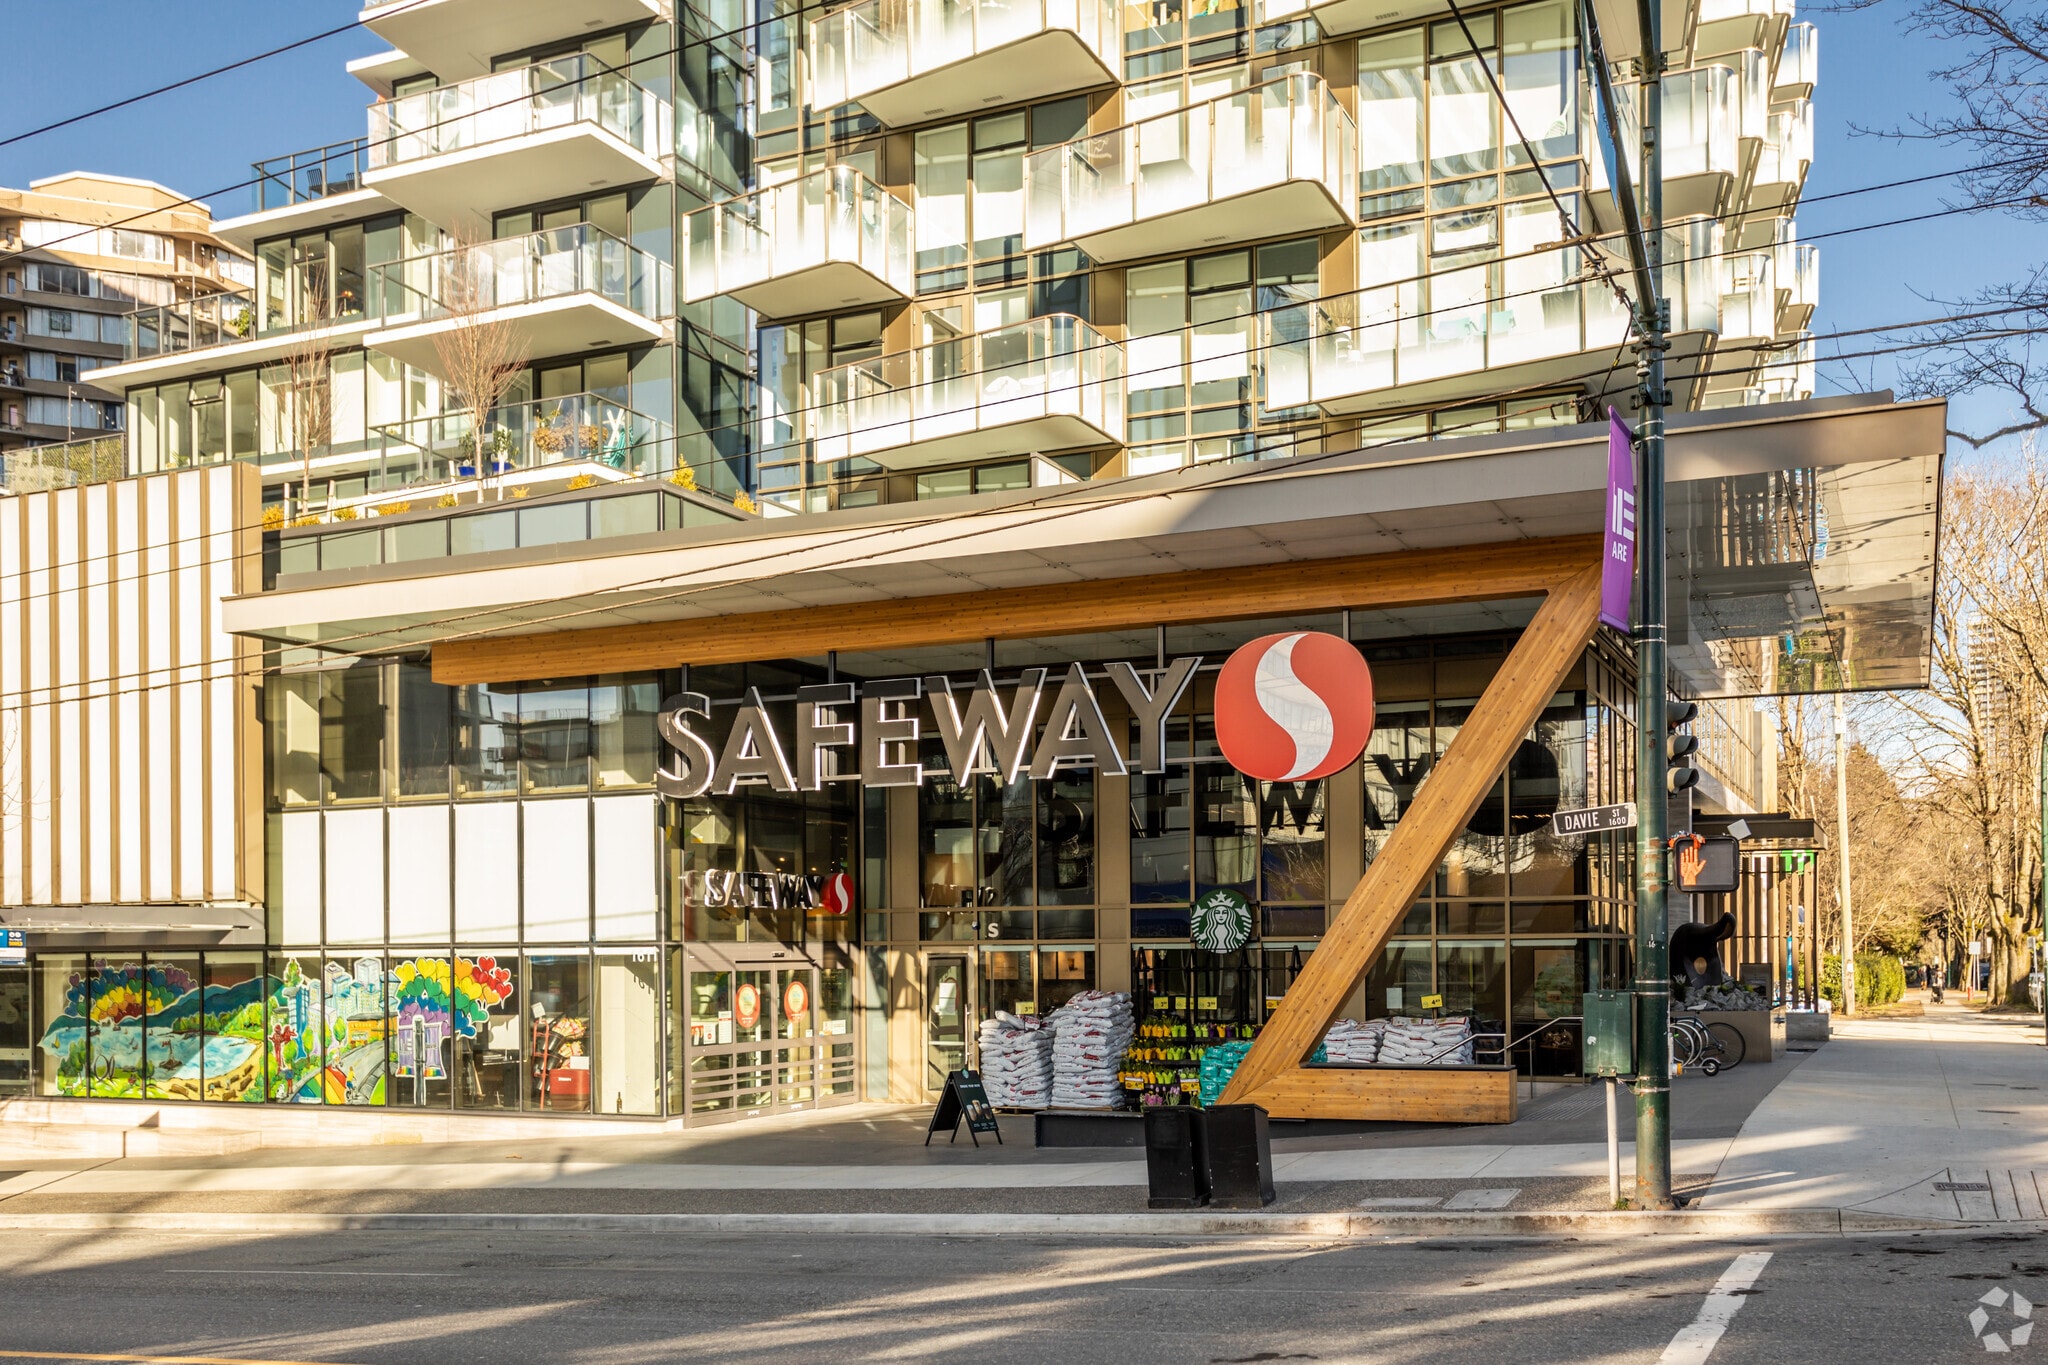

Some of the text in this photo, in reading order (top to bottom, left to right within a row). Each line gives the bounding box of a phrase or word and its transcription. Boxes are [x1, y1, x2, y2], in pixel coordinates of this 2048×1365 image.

[1611, 540, 1628, 562] ARE
[656, 655, 1203, 799] SAFEWAY
[1564, 808, 1620, 831] DAVIE ST
[1608, 817, 1627, 826] 1600
[704, 868, 823, 909] SAFEWAY
